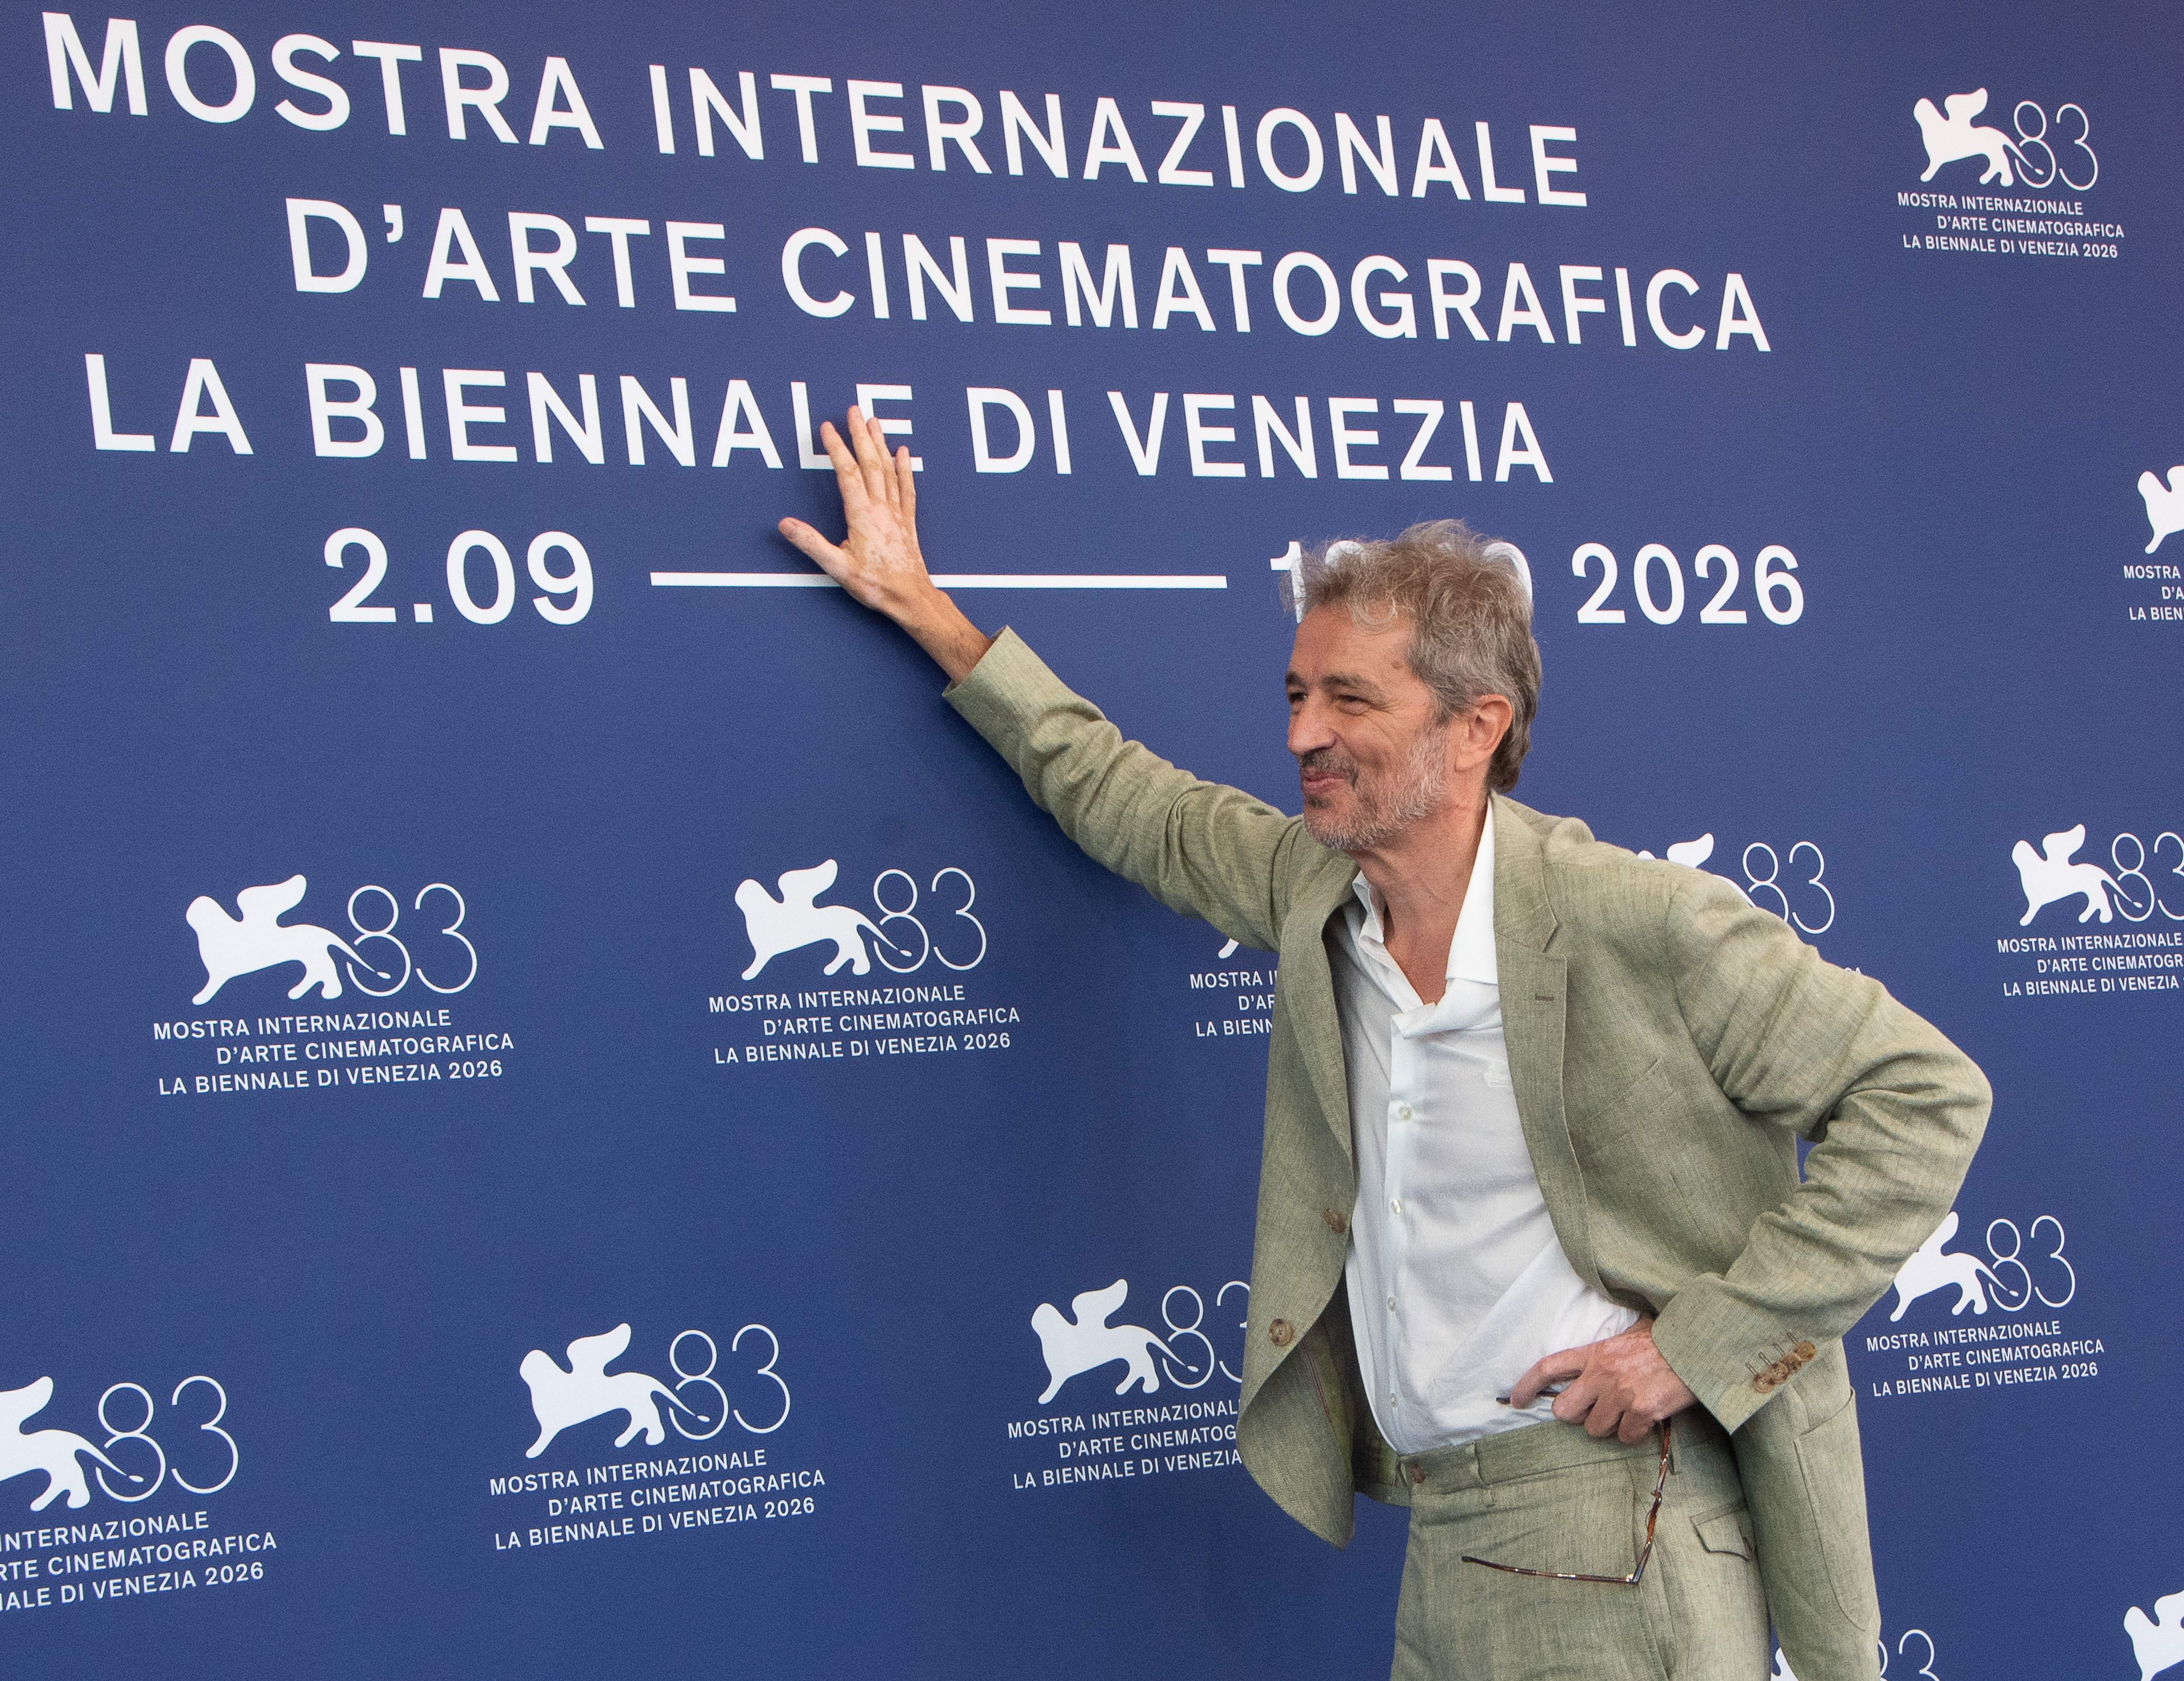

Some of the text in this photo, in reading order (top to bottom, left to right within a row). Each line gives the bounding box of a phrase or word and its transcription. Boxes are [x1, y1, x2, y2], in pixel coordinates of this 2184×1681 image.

[42, 12, 1587, 206] MOSTRA INTERNAZIONALE
[2014, 100, 2098, 190] 83
[1898, 192, 2083, 215] MOSTRA INTERNAZIONALE
[1938, 215, 2124, 237] D'ARTE CINEMATOGRAFICA
[1903, 235, 2117, 257] LA BIENNALE DI VENEZIA 2026
[286, 198, 1771, 351] D'ARTE CINEMATOGRAFICA
[85, 353, 1553, 482] LA BIENNALE DI VENEZIA
[324, 527, 593, 624] 2.09
[1572, 543, 1804, 625] 2026
[2124, 565, 2181, 578] MOSTRA
[2129, 607, 2184, 620] LA BIEN
[1743, 841, 1835, 934] 83
[2112, 832, 2184, 921] 83
[874, 868, 986, 972] 83
[346, 883, 477, 996] 83
[1997, 933, 2183, 952] MOSTRA INTERNAZIONALE
[1190, 971, 1262, 988] MOSTRA
[2038, 954, 2183, 972] D'ARTE CINEMATOGR
[709, 986, 964, 1012] MOSTRA INTERNAZIONALE
[2004, 975, 2179, 996] LA BIENNALE DI VENEZIA
[154, 1010, 451, 1039] MOSTRA INTERNAZIONALE
[764, 1007, 1019, 1035] D'ARTE CINEMATOGRAFICA
[1196, 1021, 1217, 1036] LA
[217, 1033, 513, 1064] D'ARTE CINEMATOGRAFICA
[715, 1033, 1009, 1063] LA BIENNALE DI VENEZIA 2026
[159, 1060, 501, 1094] LA BIENNALE DI VENEZIA 2026
[1987, 1215, 2075, 1311] 83
[1867, 1321, 2061, 1351] MOSTRA INTERNAZIONALE
[1909, 1339, 2104, 1370] D'ARTE CINEMATOGRAFICA
[669, 1324, 790, 1439] 83
[1873, 1362, 2098, 1396] LA BIENNALE DI VENEZIA 2026
[1008, 1399, 1240, 1438] MOSTRA INTERNAZIONAL
[96, 1376, 238, 1502] 83
[1060, 1437, 1124, 1458] D'ARTE
[490, 1449, 766, 1495] MOSTRA INTERNAZIONALE
[1014, 1449, 1242, 1488] LA BIENNALE DI VENEZIA
[549, 1470, 825, 1515] D'ARTE CINEMATOGRAFICA
[496, 1498, 814, 1549] LA BIENNALE DI VENEZIA 2026
[48, 1532, 276, 1574] CINEMATOGRAFICA
[0, 1562, 263, 1610] ALE DI VENEZIA 2026
